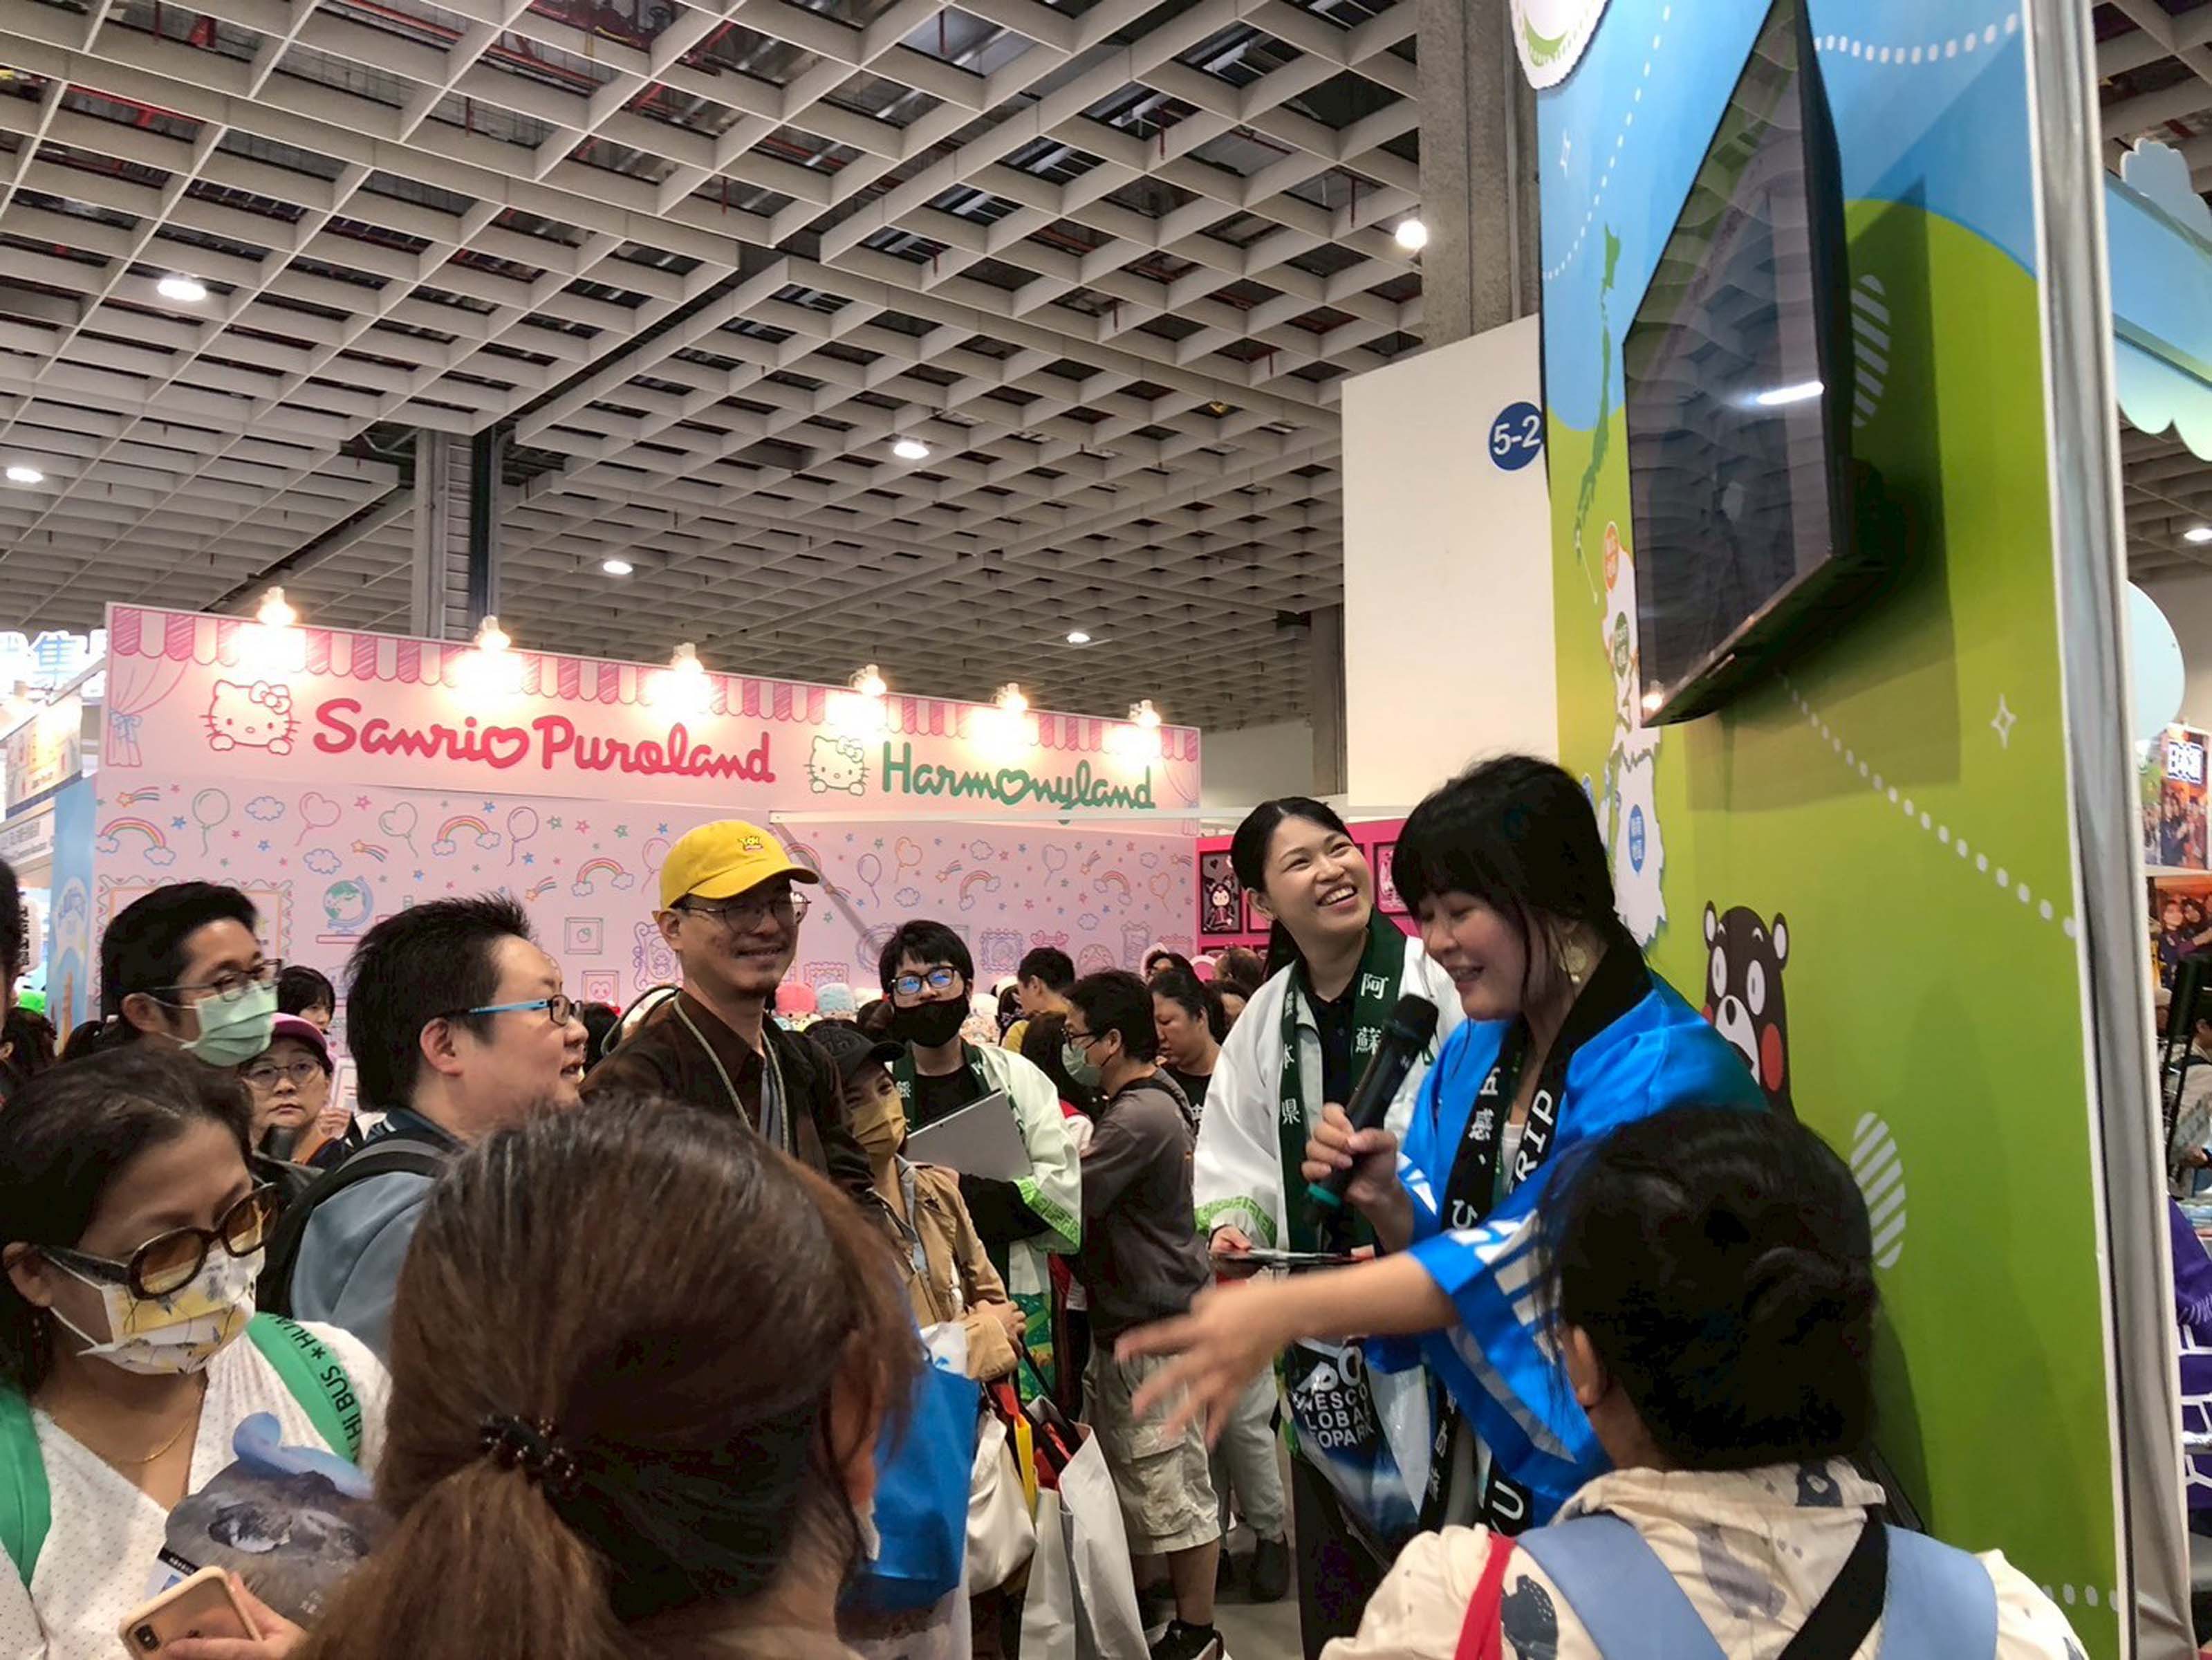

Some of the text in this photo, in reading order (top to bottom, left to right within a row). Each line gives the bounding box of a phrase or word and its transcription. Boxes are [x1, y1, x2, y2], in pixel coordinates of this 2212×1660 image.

[1494, 414, 1541, 455] 5-2
[313, 697, 775, 783] Sanrio Puroland
[882, 740, 1156, 824] Harmonyland
[1509, 1089, 1554, 1195] RIP
[320, 1365, 355, 1413] BUS
[1304, 1401, 1372, 1431] LOBAL
